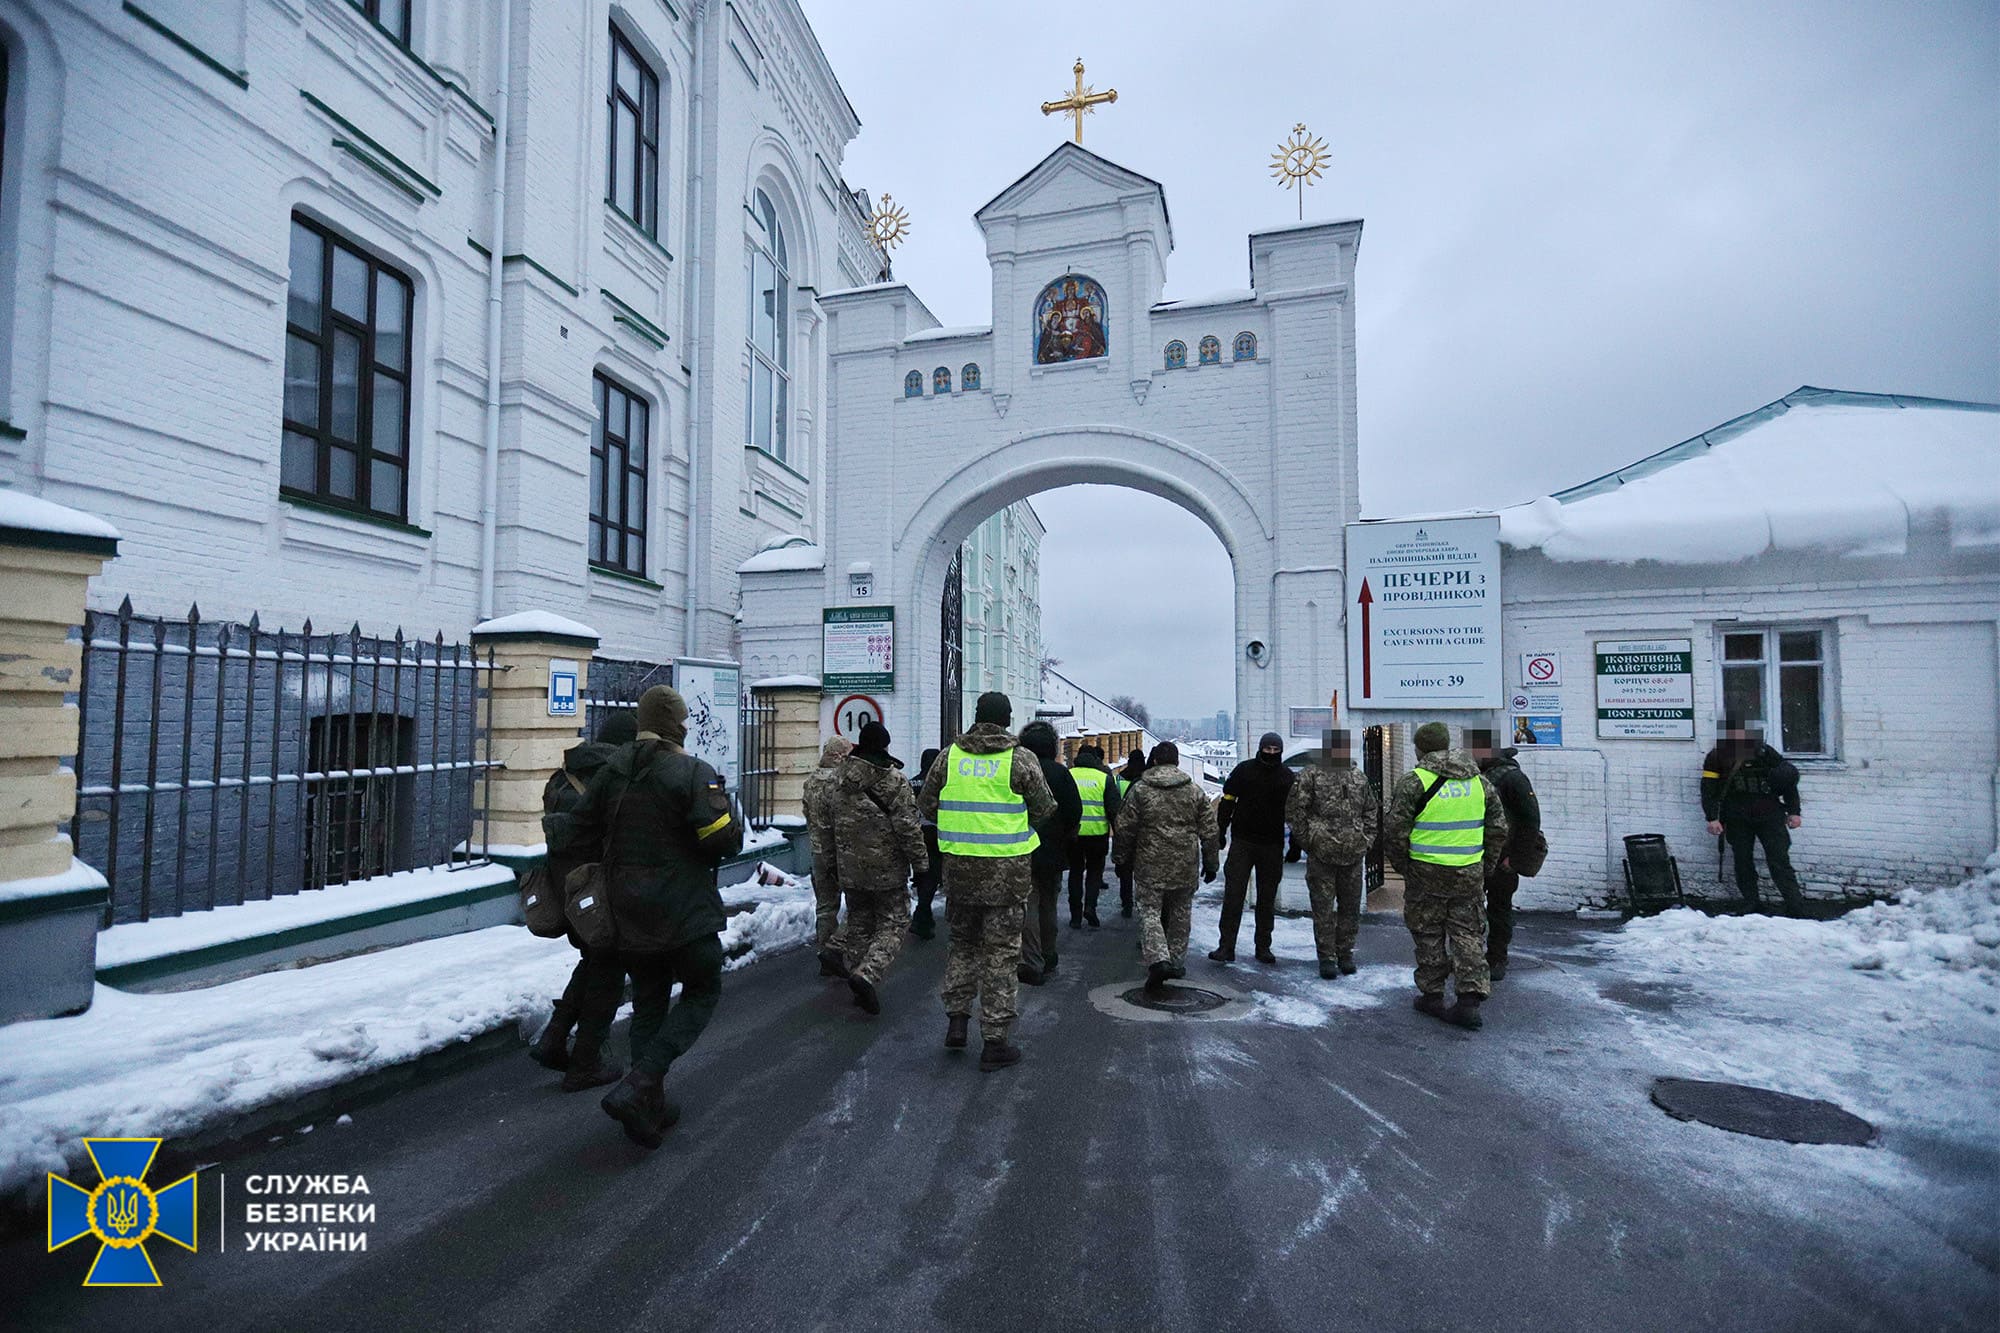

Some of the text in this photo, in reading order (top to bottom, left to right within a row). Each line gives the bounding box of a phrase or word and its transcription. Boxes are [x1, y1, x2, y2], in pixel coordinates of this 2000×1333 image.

[1384, 571, 1471, 587] ПЕЧЕРИ
[856, 586, 867, 595] 15
[1383, 589, 1485, 602] ПРОВІДНИКОМ
[1383, 627, 1445, 636] EXCURSIONS
[1605, 654, 1681, 663] ІКОНОПИСНА
[1400, 675, 1464, 687] КОРПУС 39
[1637, 710, 1683, 718] STUDIO
[845, 711, 871, 732] 10
[959, 758, 1000, 778] СБУ
[1438, 780, 1471, 799] СБУ
